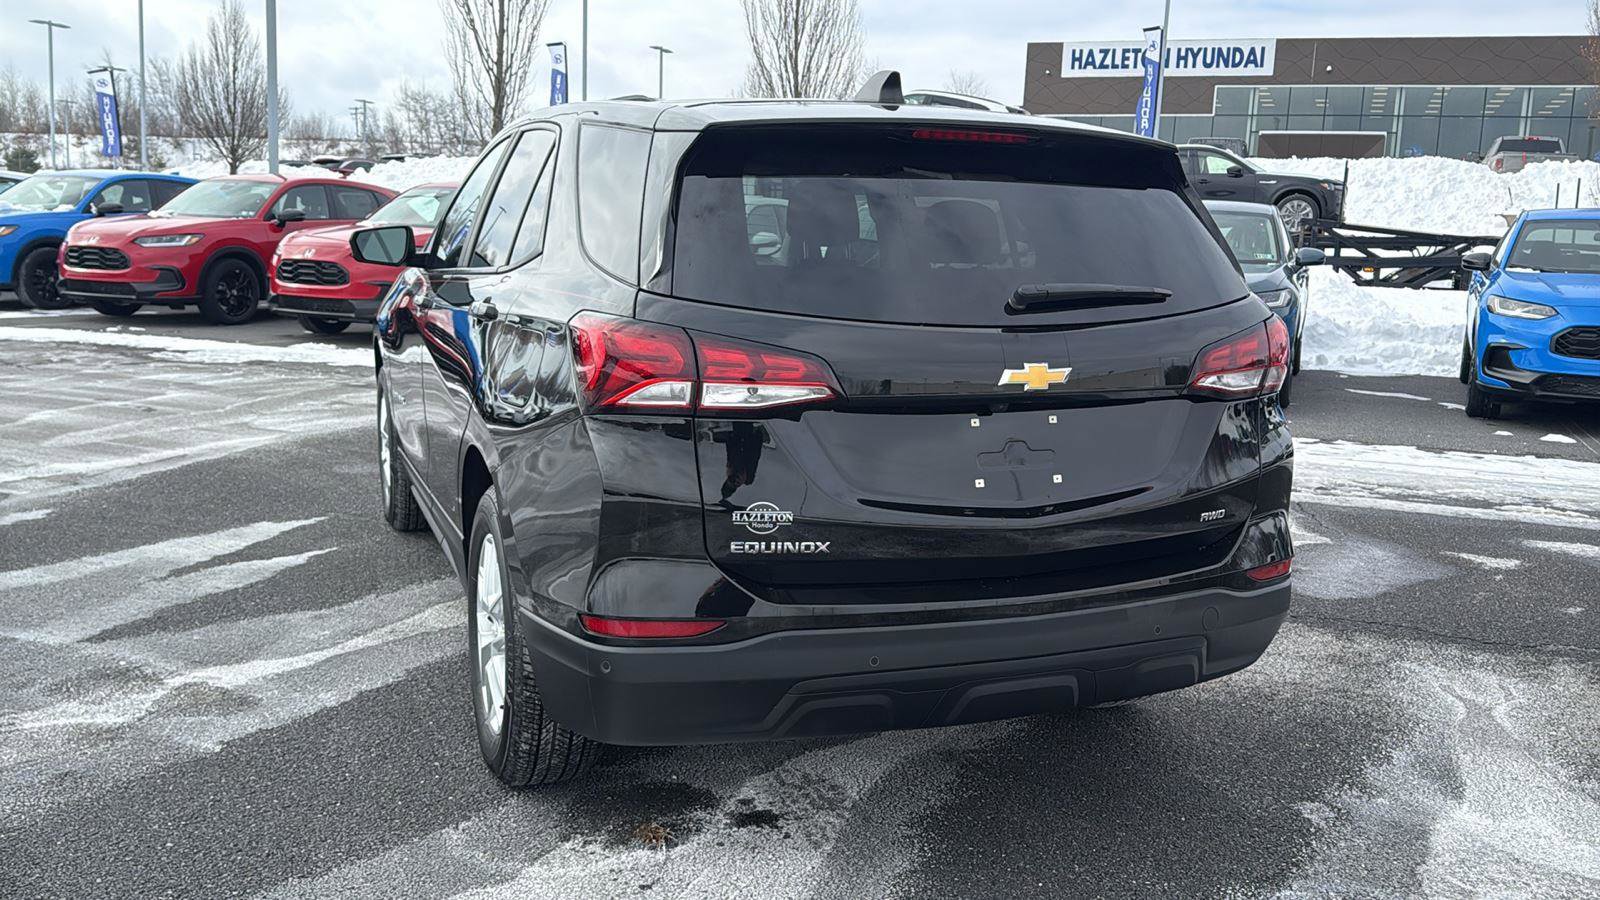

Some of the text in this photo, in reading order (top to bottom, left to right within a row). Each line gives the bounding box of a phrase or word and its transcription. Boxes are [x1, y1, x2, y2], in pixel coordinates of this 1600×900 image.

[1071, 46, 1266, 70] HAZLET HYUNDAI
[731, 512, 794, 522] HAZLETON
[1200, 509, 1226, 522] AWD
[751, 521, 774, 529] Honda
[730, 541, 831, 554] EQUINOX
